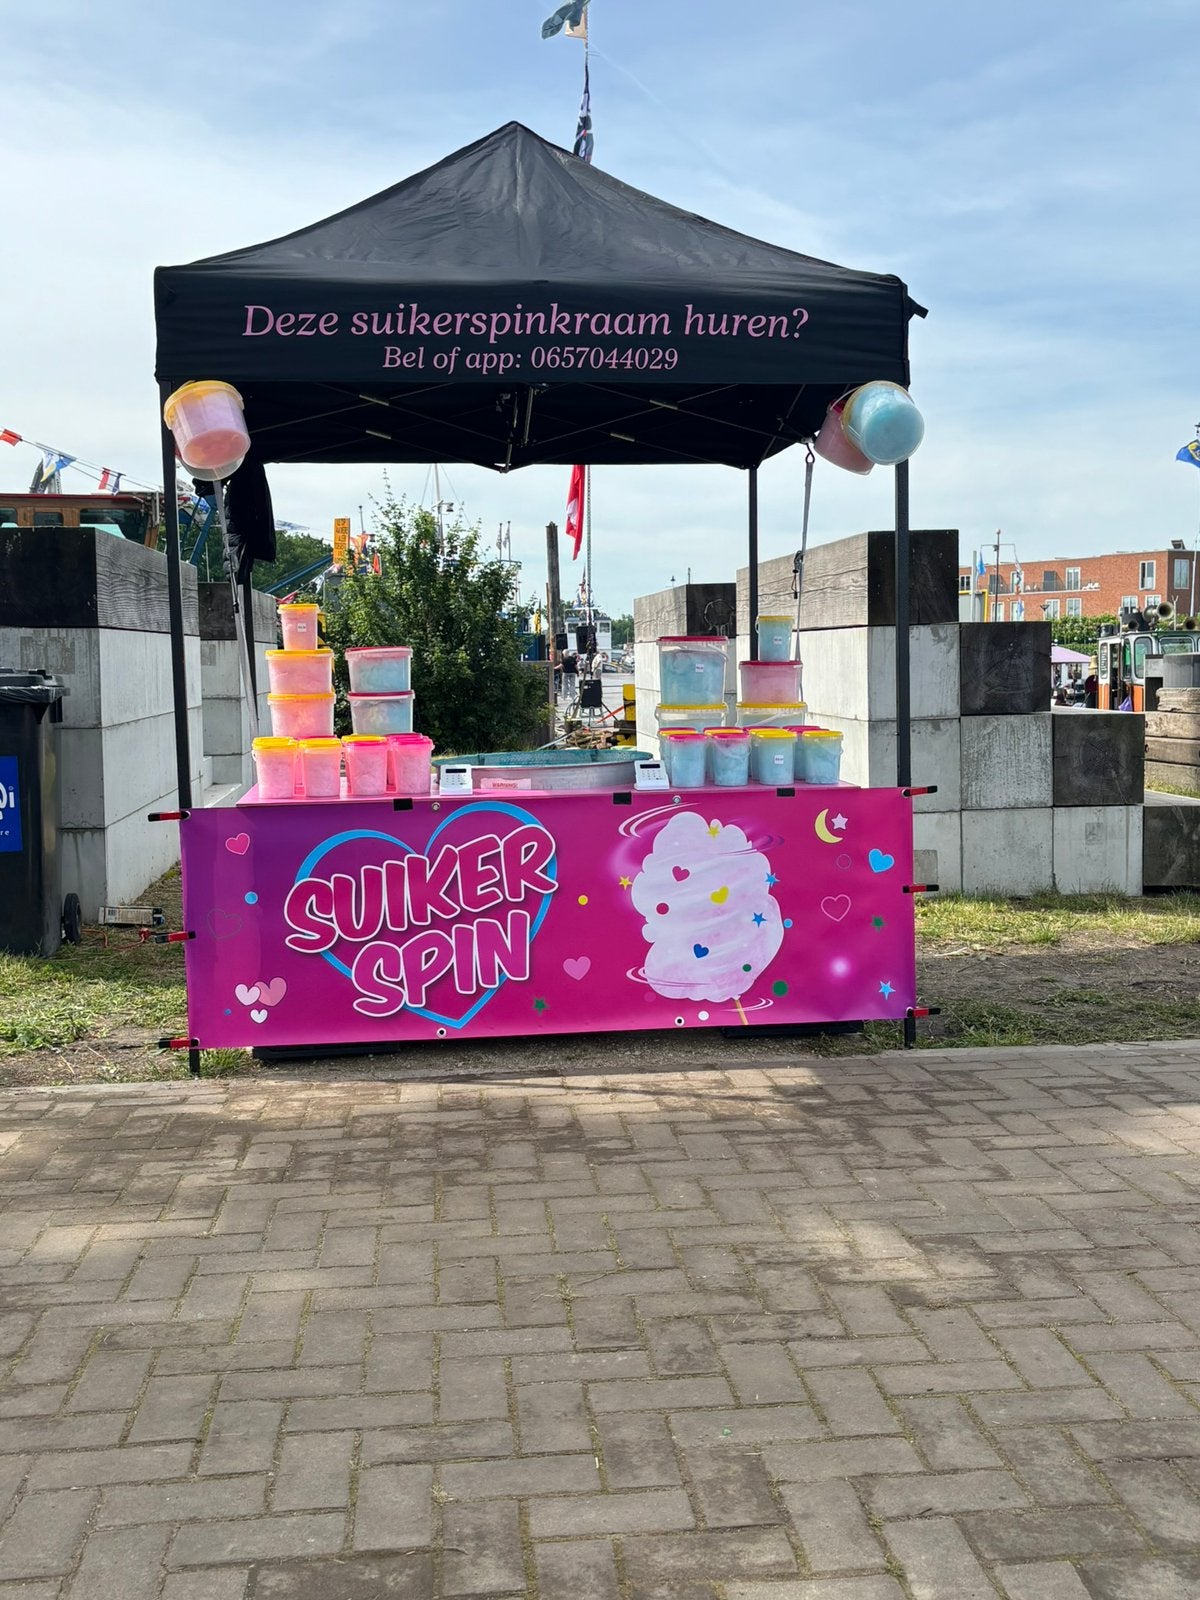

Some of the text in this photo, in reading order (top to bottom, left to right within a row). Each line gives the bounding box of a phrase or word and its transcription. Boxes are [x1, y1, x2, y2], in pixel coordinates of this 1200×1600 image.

[242, 303, 810, 344] Deze suikerspinkraam huren?
[382, 346, 679, 375] Bel of app: 0657044029
[284, 823, 559, 954] SUIKER
[351, 909, 531, 1018] SPIN
